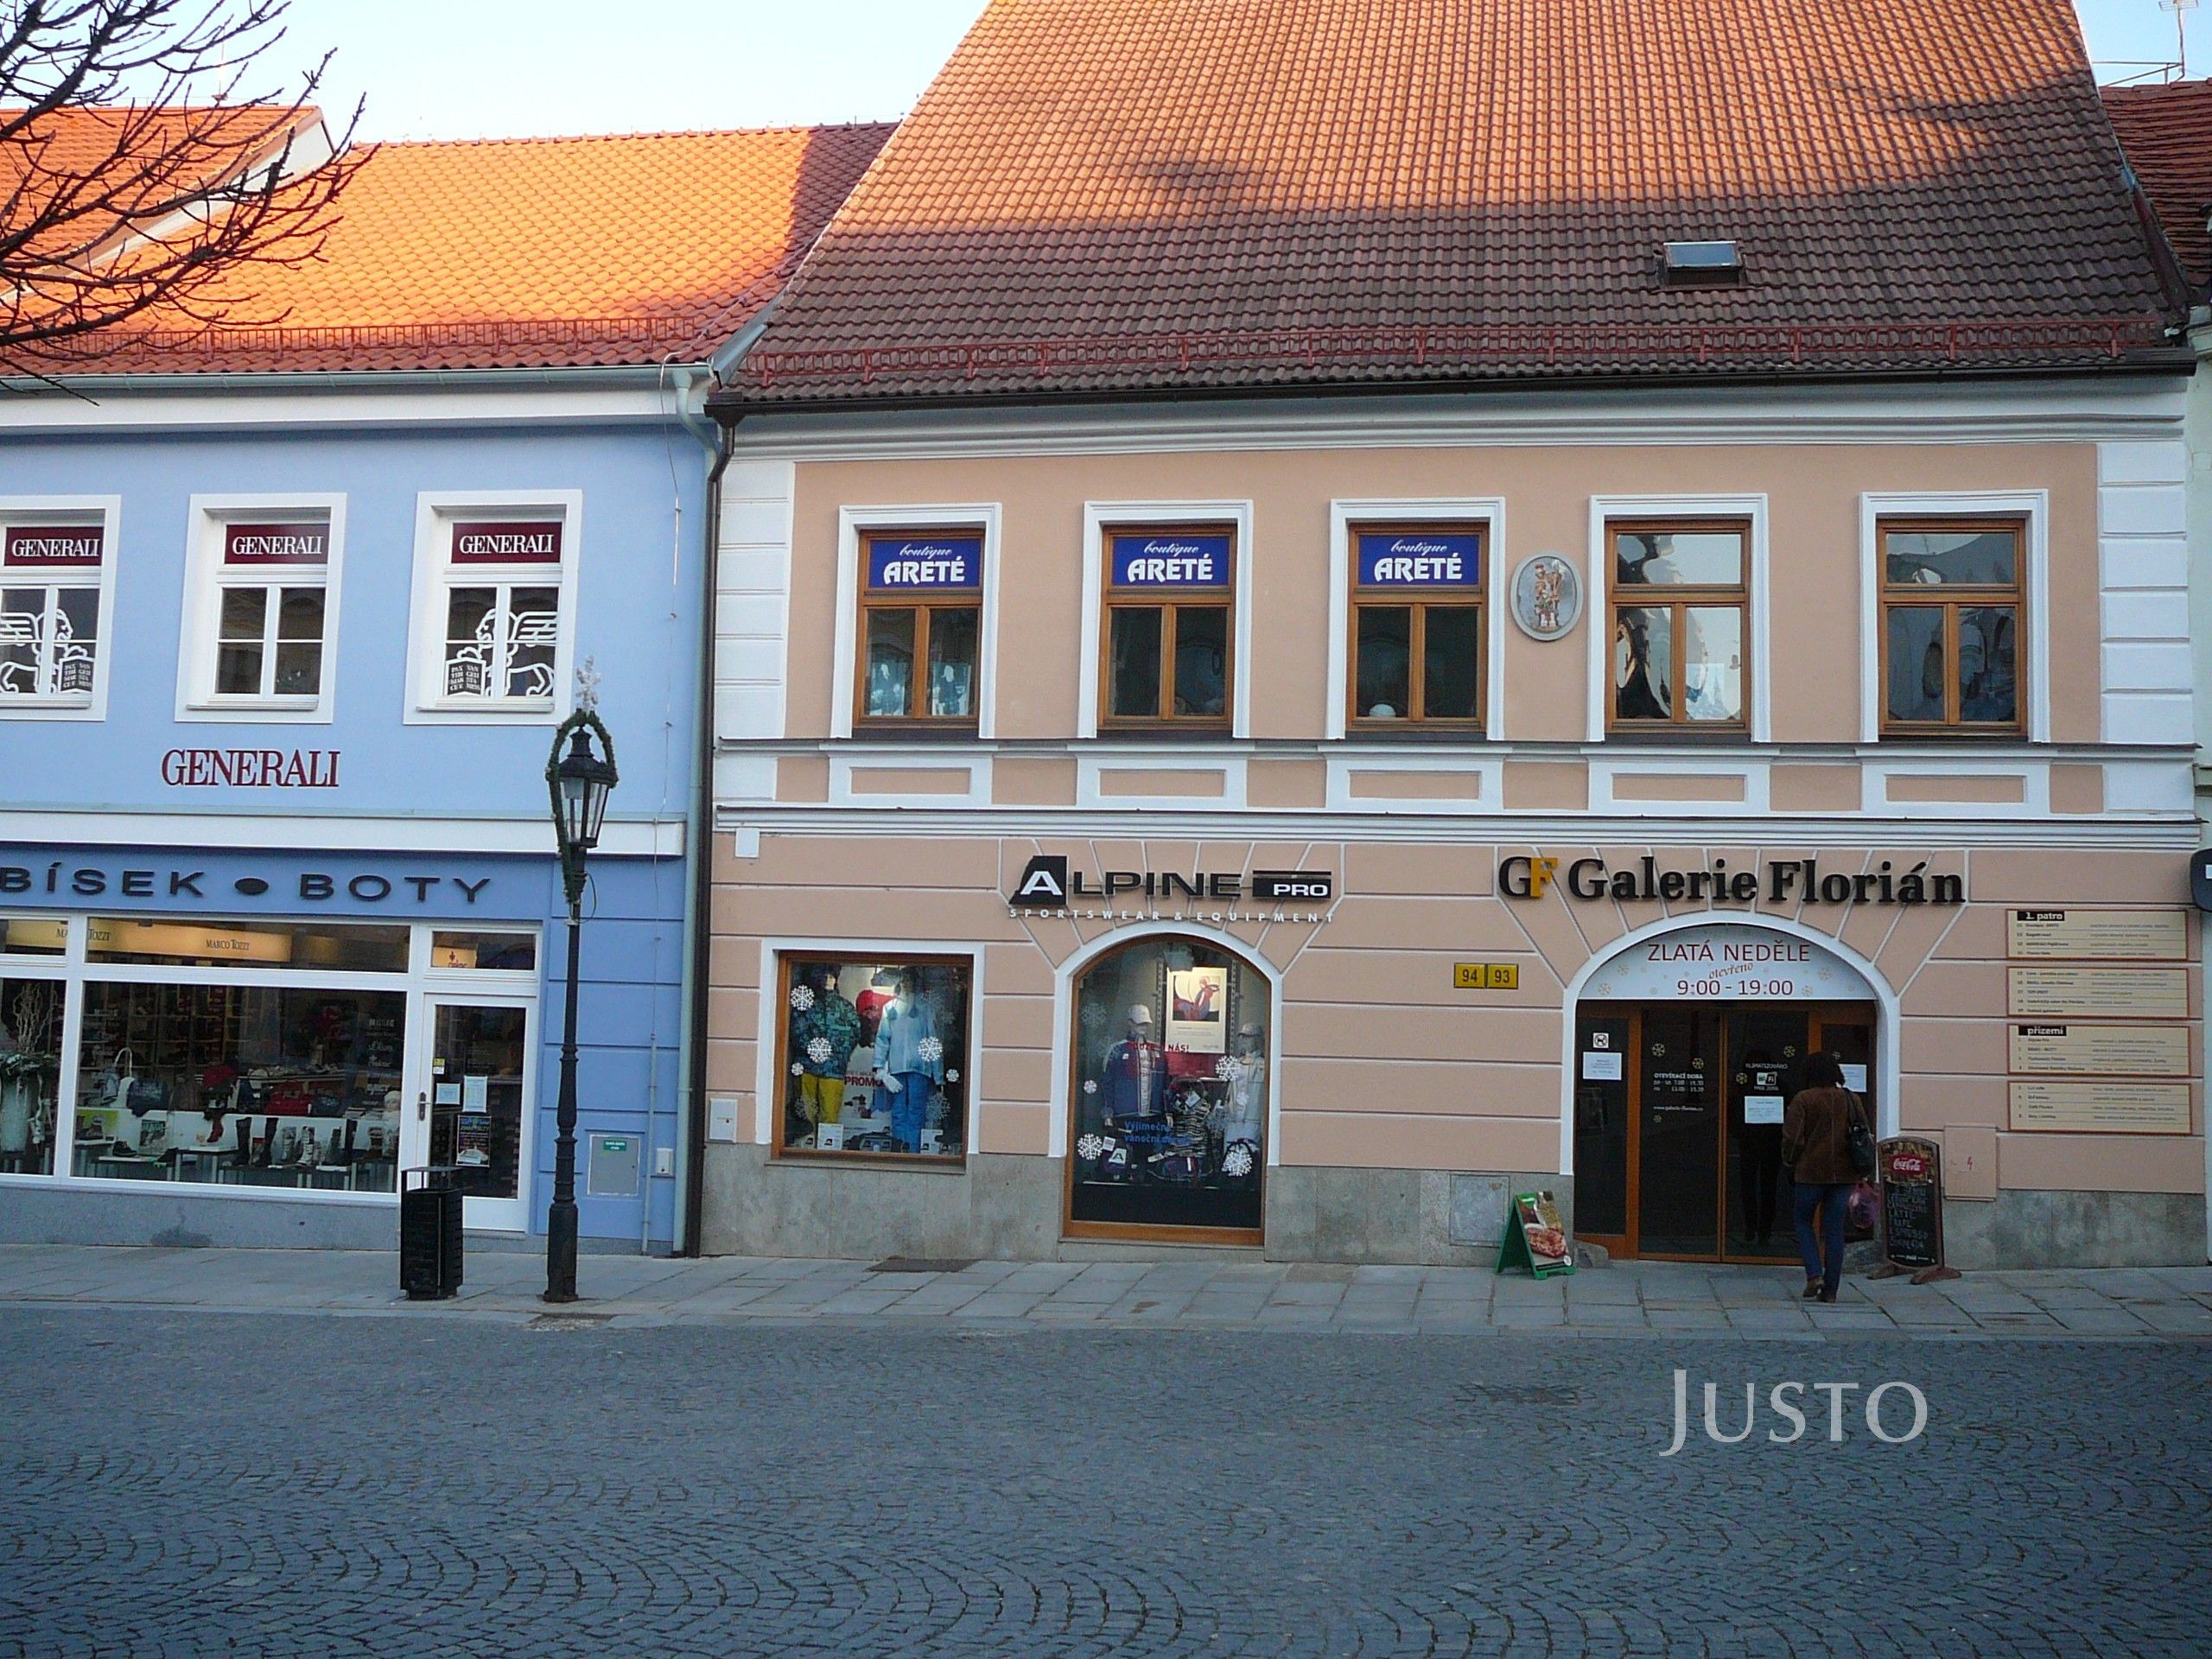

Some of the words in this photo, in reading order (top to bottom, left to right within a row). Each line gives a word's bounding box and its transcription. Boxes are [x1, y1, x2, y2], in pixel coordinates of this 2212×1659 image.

[11, 537, 101, 558] GENERALI
[232, 535, 324, 556] GENERALI
[459, 532, 554, 556] GENERALI
[899, 543, 952, 558] boutique
[1143, 540, 1199, 556] boutique
[1390, 539, 1449, 556] boutique
[883, 556, 966, 585] ARETÉ
[1127, 553, 1213, 584] ARETÉ
[1374, 552, 1463, 582] ARETÉ
[162, 748, 341, 788] GENERALI
[0, 861, 205, 896] BÍSEK
[301, 873, 492, 904] BOTY
[1020, 870, 1243, 897] ALPINE
[1274, 883, 1329, 897] PRO
[1567, 855, 1758, 901] Galerie
[1768, 861, 1967, 905] Florián
[1009, 908, 1160, 921] SPORTSWEAR
[1174, 912, 1183, 921] &
[1197, 912, 1334, 924] EQUIPMENT
[2037, 912, 2063, 922] patro
[206, 938, 230, 950] MARCO
[1647, 938, 1713, 962] ZLATÁ
[1724, 938, 1810, 962] NEDĚLE
[1461, 969, 1478, 982] 94
[1493, 969, 1510, 983] 93
[1707, 961, 1754, 980] otevřeno
[1676, 978, 1721, 996] 9:00
[1738, 978, 1795, 996] 19:00
[2027, 1027, 2063, 1036] přízemí
